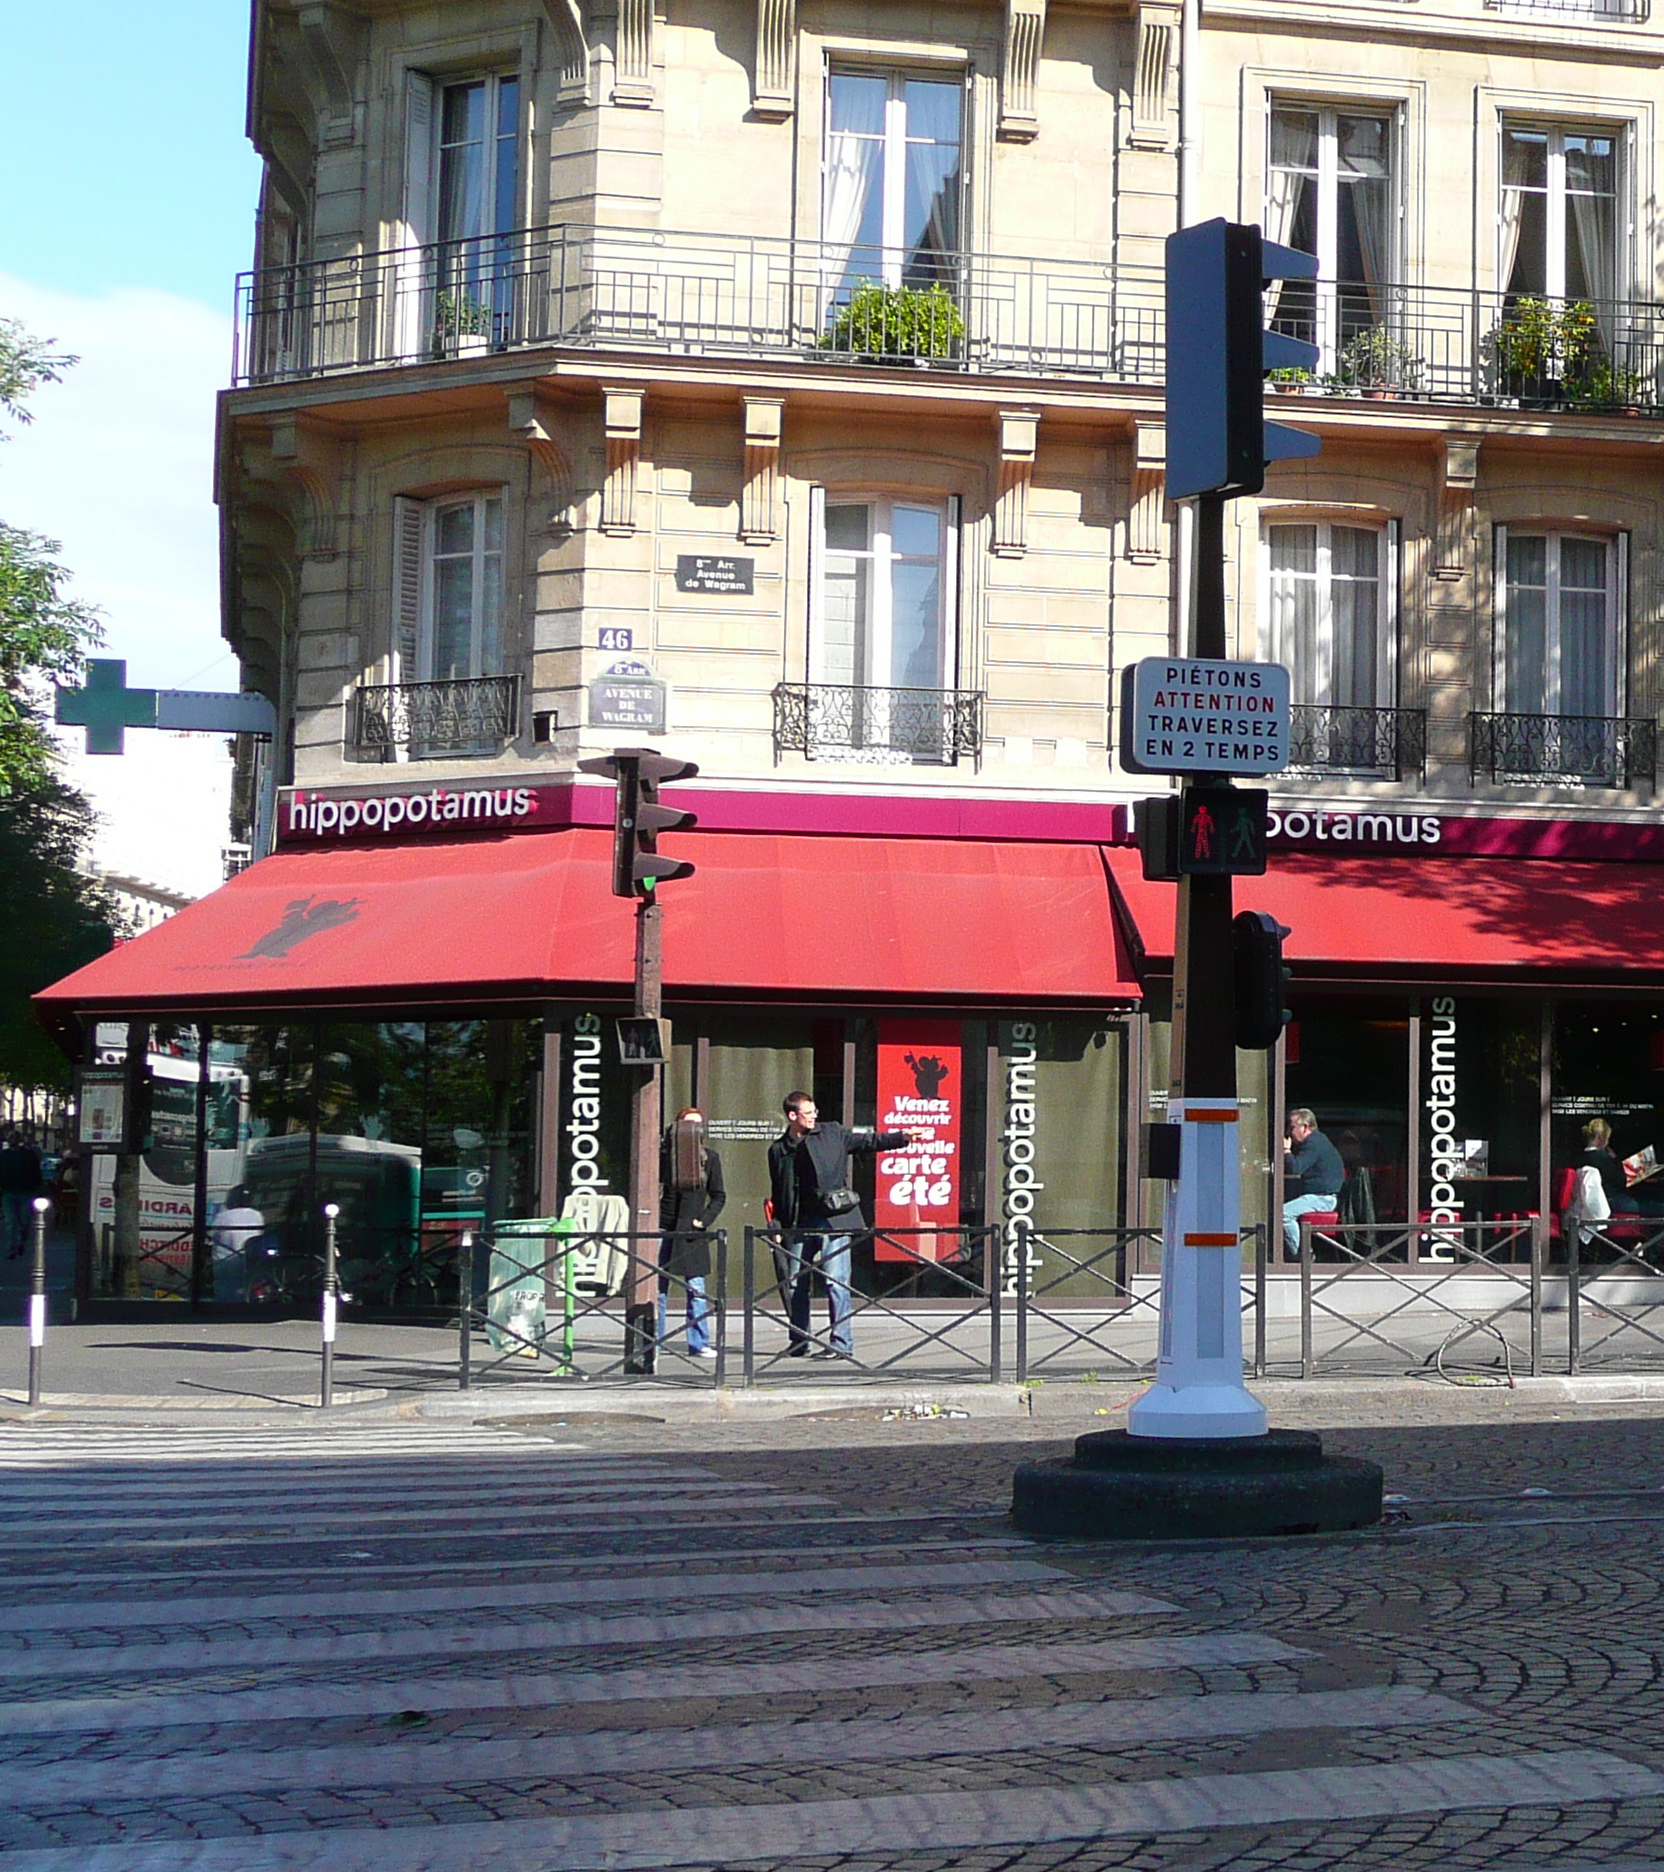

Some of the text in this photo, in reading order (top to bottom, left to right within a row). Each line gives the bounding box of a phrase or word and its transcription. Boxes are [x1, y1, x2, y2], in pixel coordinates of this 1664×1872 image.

[685, 578, 746, 591] de Wagram
[696, 569, 736, 580] Avenue
[601, 630, 629, 650] 46
[1166, 665, 1262, 689] PIÉTONS
[603, 688, 653, 700] AVENUE
[1153, 691, 1275, 714] ATTENTION
[618, 700, 636, 710] DE
[602, 711, 653, 724] WAGRAM
[1148, 715, 1279, 738] TRAVERSEZ
[1146, 738, 1280, 761] EN 2 TEMPS
[289, 788, 530, 836] hippopotamus
[894, 1096, 950, 1112] Venez
[884, 1112, 952, 1125] découvrir
[1418, 996, 1464, 1263] hippopotamus
[881, 1154, 947, 1174] carte
[1000, 1021, 1044, 1297] hippopotamus
[889, 1174, 952, 1206] été
